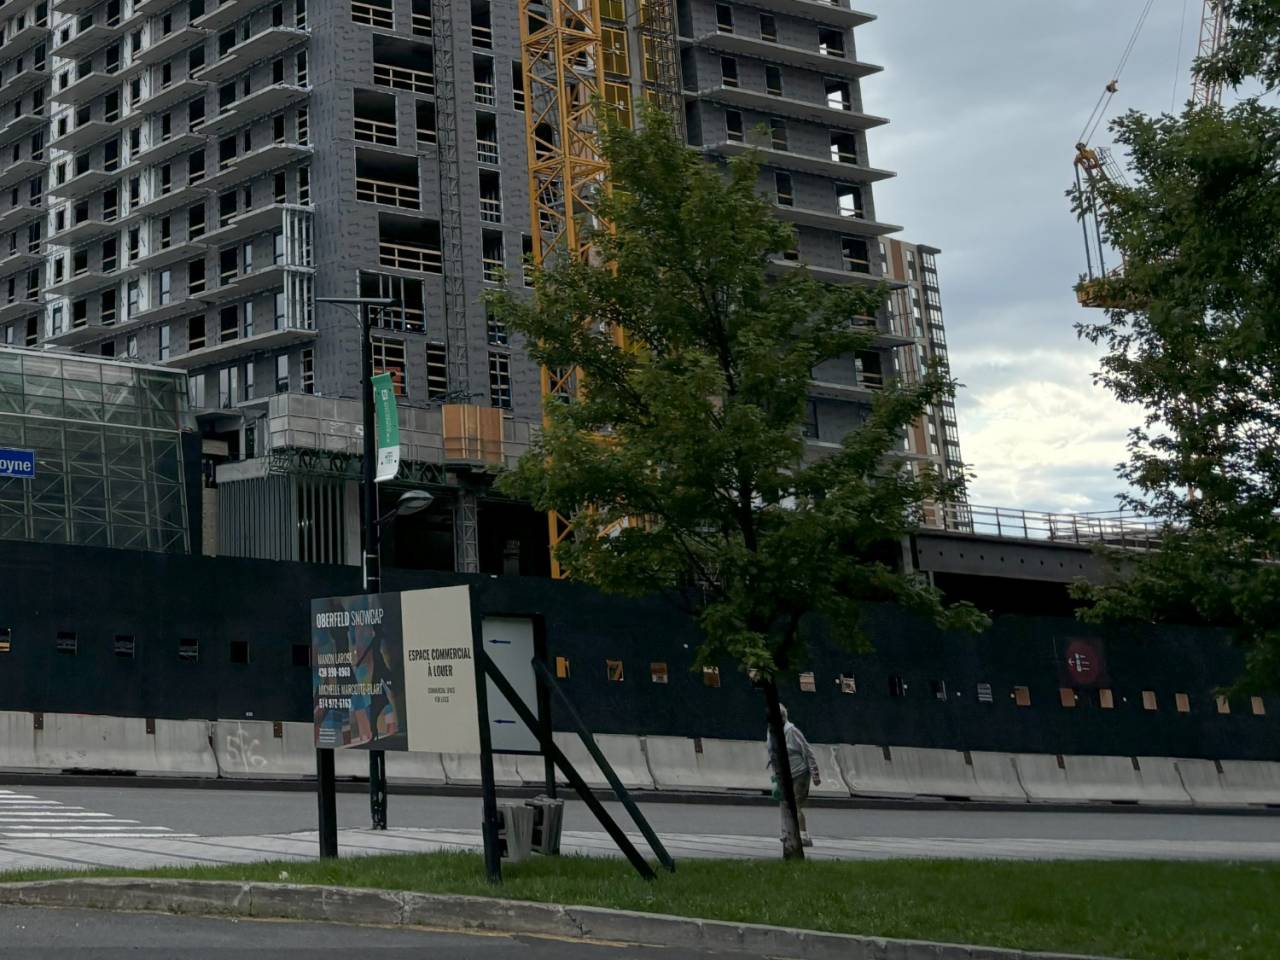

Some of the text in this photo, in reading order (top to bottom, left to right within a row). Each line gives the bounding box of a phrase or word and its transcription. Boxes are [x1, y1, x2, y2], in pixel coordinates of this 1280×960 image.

[316, 608, 384, 628] OBERFELD SNOWCAP
[408, 647, 471, 661] ESPACE COMMERCIAL
[428, 662, 453, 677] À LOUER
